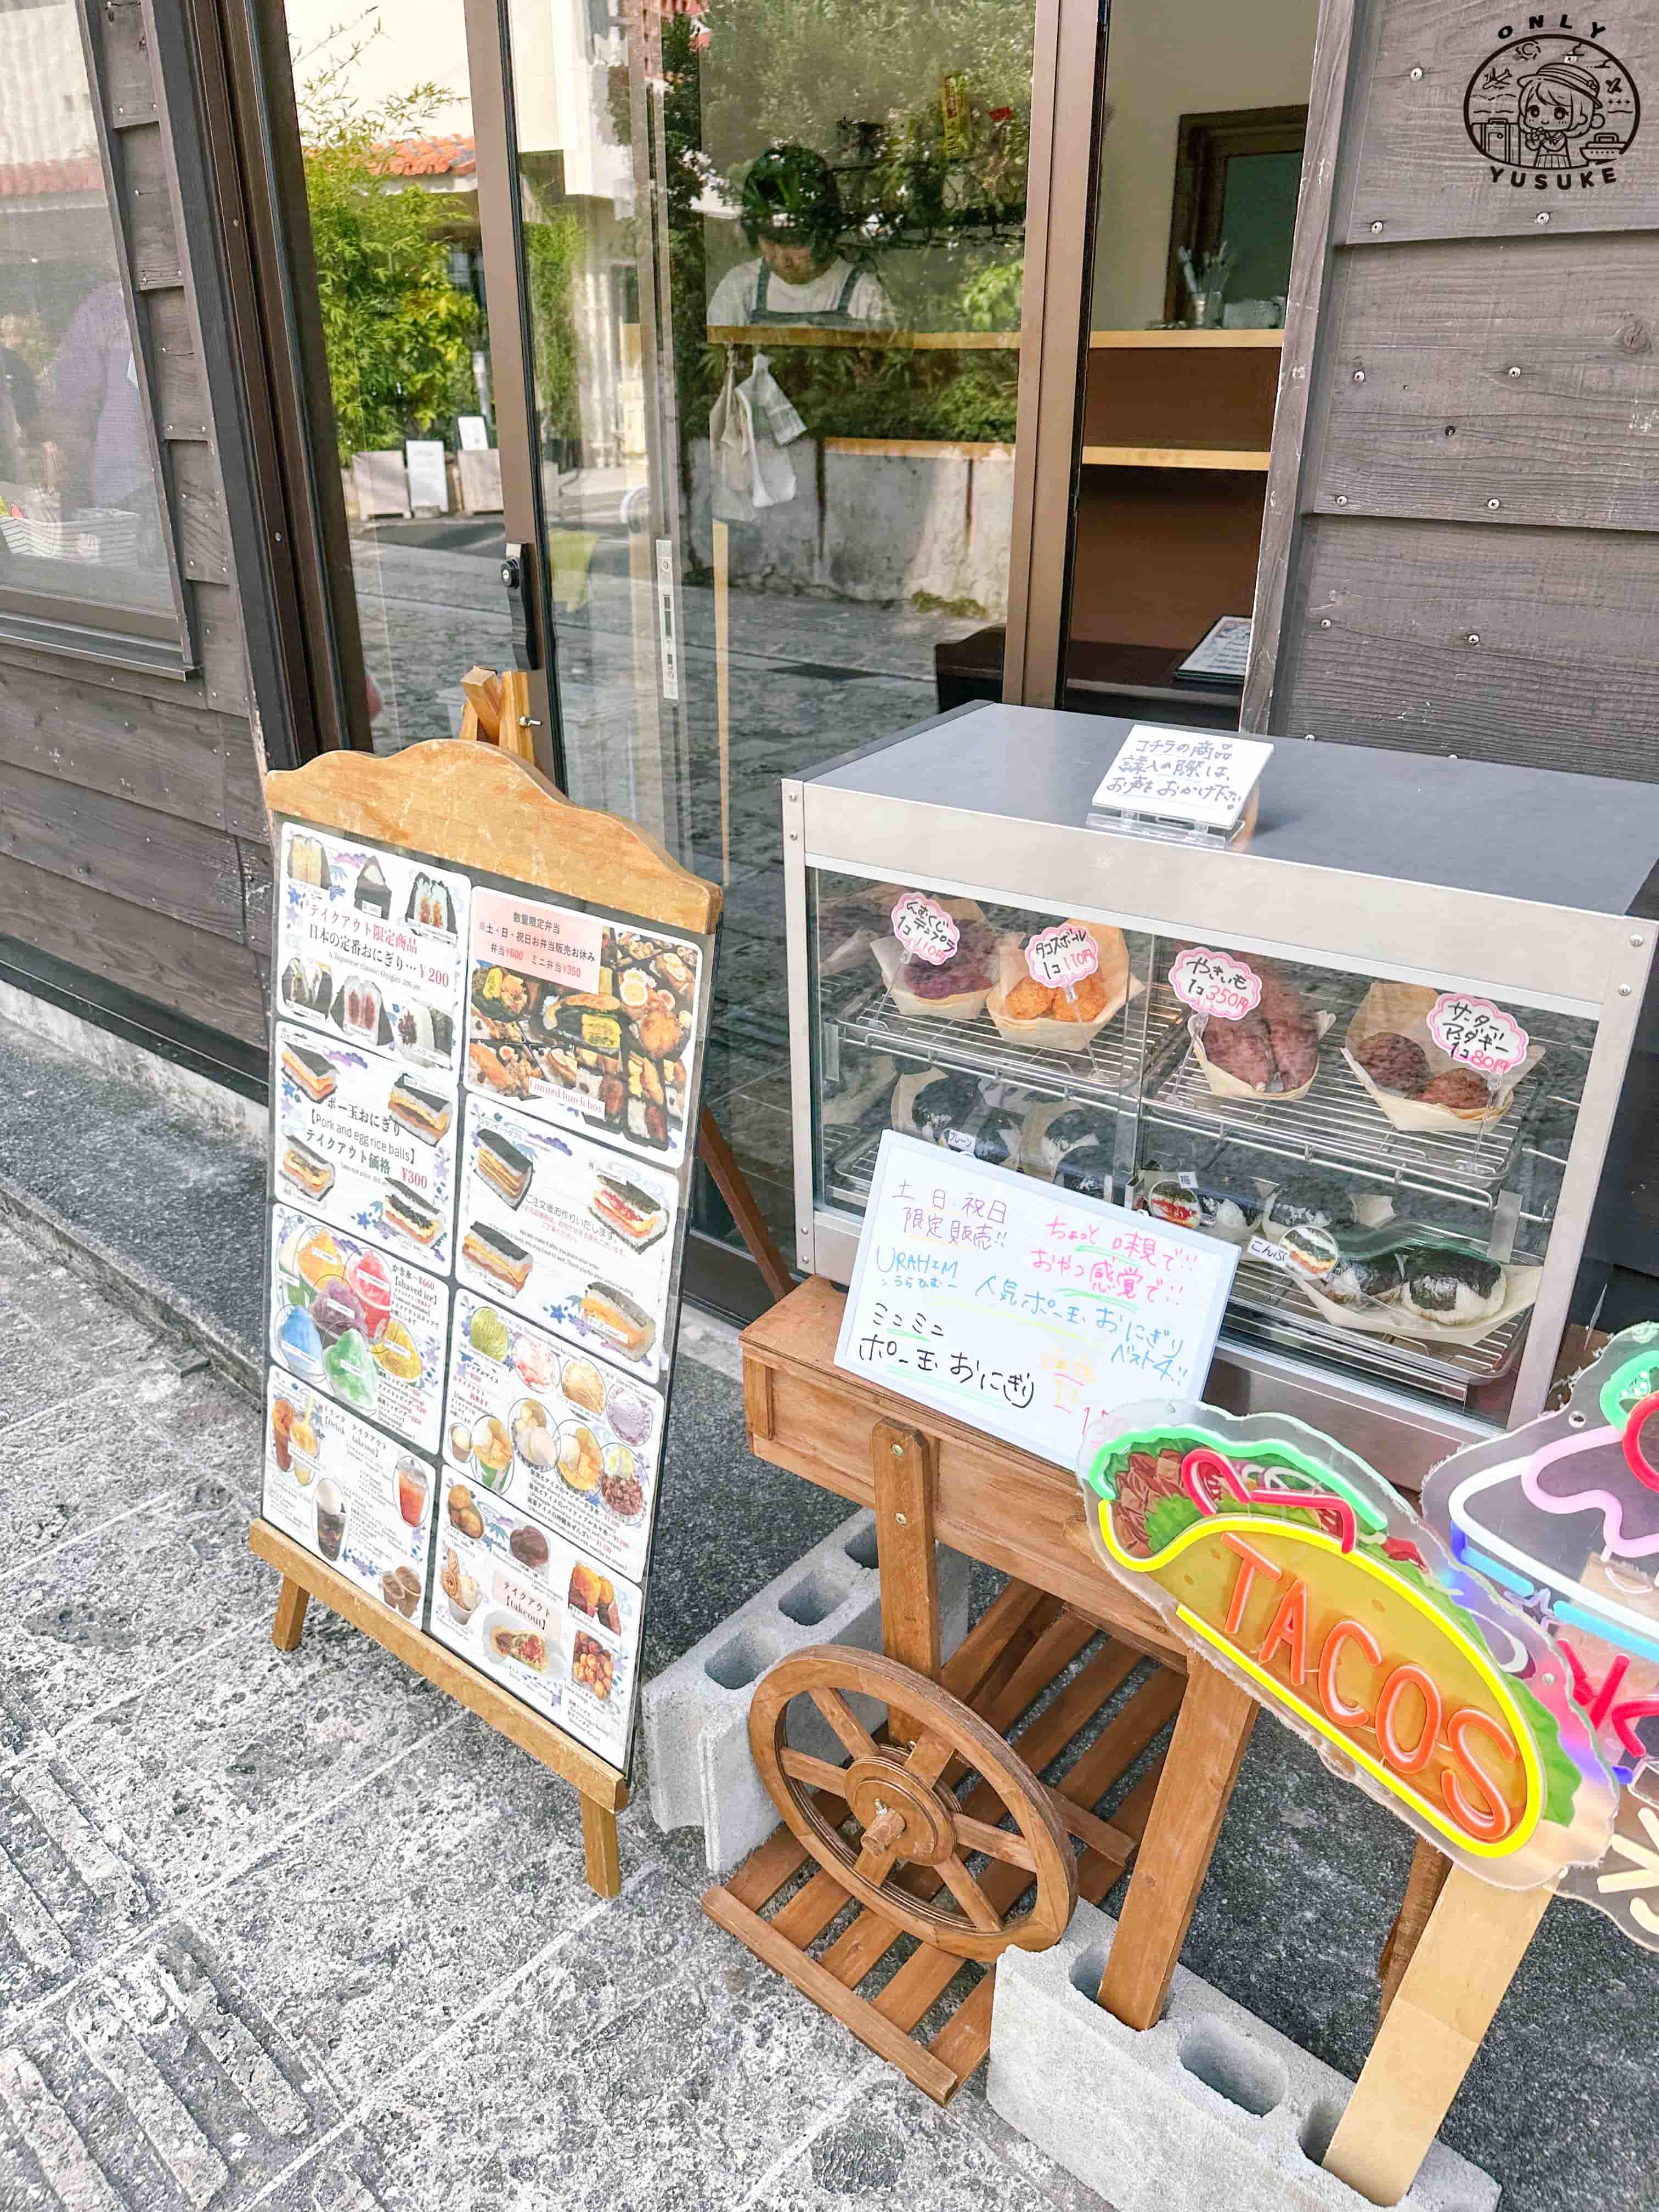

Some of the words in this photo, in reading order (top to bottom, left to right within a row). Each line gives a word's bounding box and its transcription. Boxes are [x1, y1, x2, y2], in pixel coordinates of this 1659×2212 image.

[310, 904, 418, 955] テイクアウト限定商品
[513, 911, 561, 935] 数量限定弁当
[1187, 956, 1248, 991] やきいも
[1205, 984, 1250, 1012] 350円
[1470, 1049, 1509, 1076] 80円
[336, 1121, 353, 1138] and
[353, 1131, 369, 1148] egg
[370, 1134, 387, 1152] rice
[306, 1128, 392, 1177] テイクアウト価格
[400, 1166, 428, 1190] ¥300
[1251, 1240, 1288, 1262] こんぶ
[503, 1579, 551, 1618] テイクアウト
[1220, 1530, 1519, 1841] TACOS
